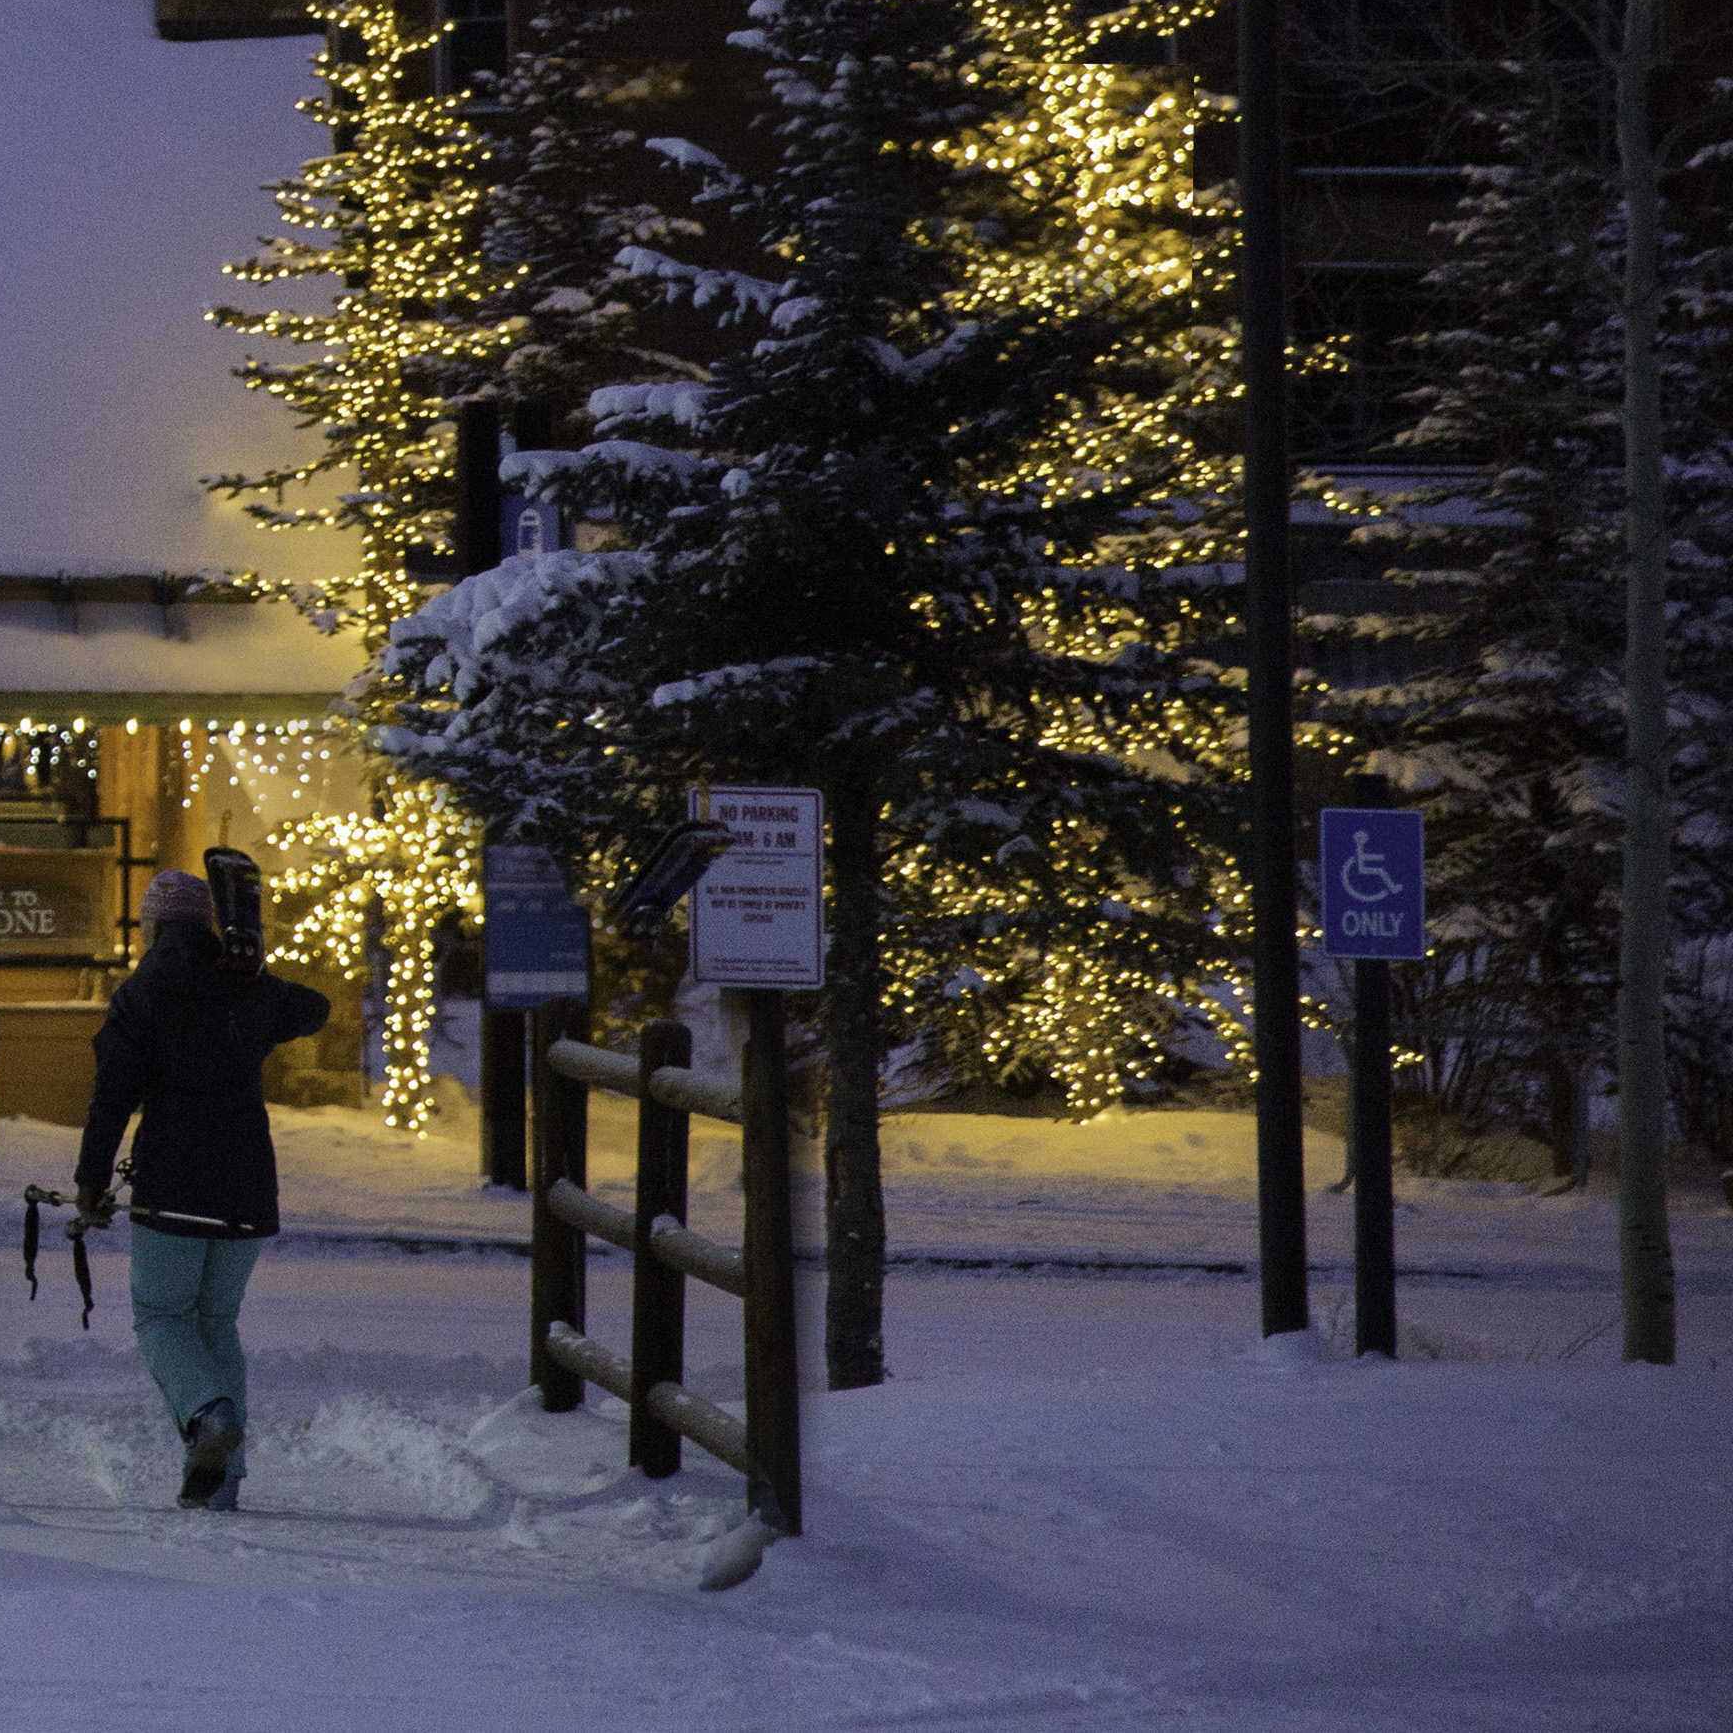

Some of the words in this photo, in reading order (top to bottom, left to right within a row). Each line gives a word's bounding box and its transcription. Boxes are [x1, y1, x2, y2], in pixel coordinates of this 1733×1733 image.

[719, 805, 737, 821] NO
[742, 805, 799, 823] PARKING
[775, 832, 796, 848] AM
[11, 890, 38, 906] TO
[1342, 910, 1405, 937] ONLY
